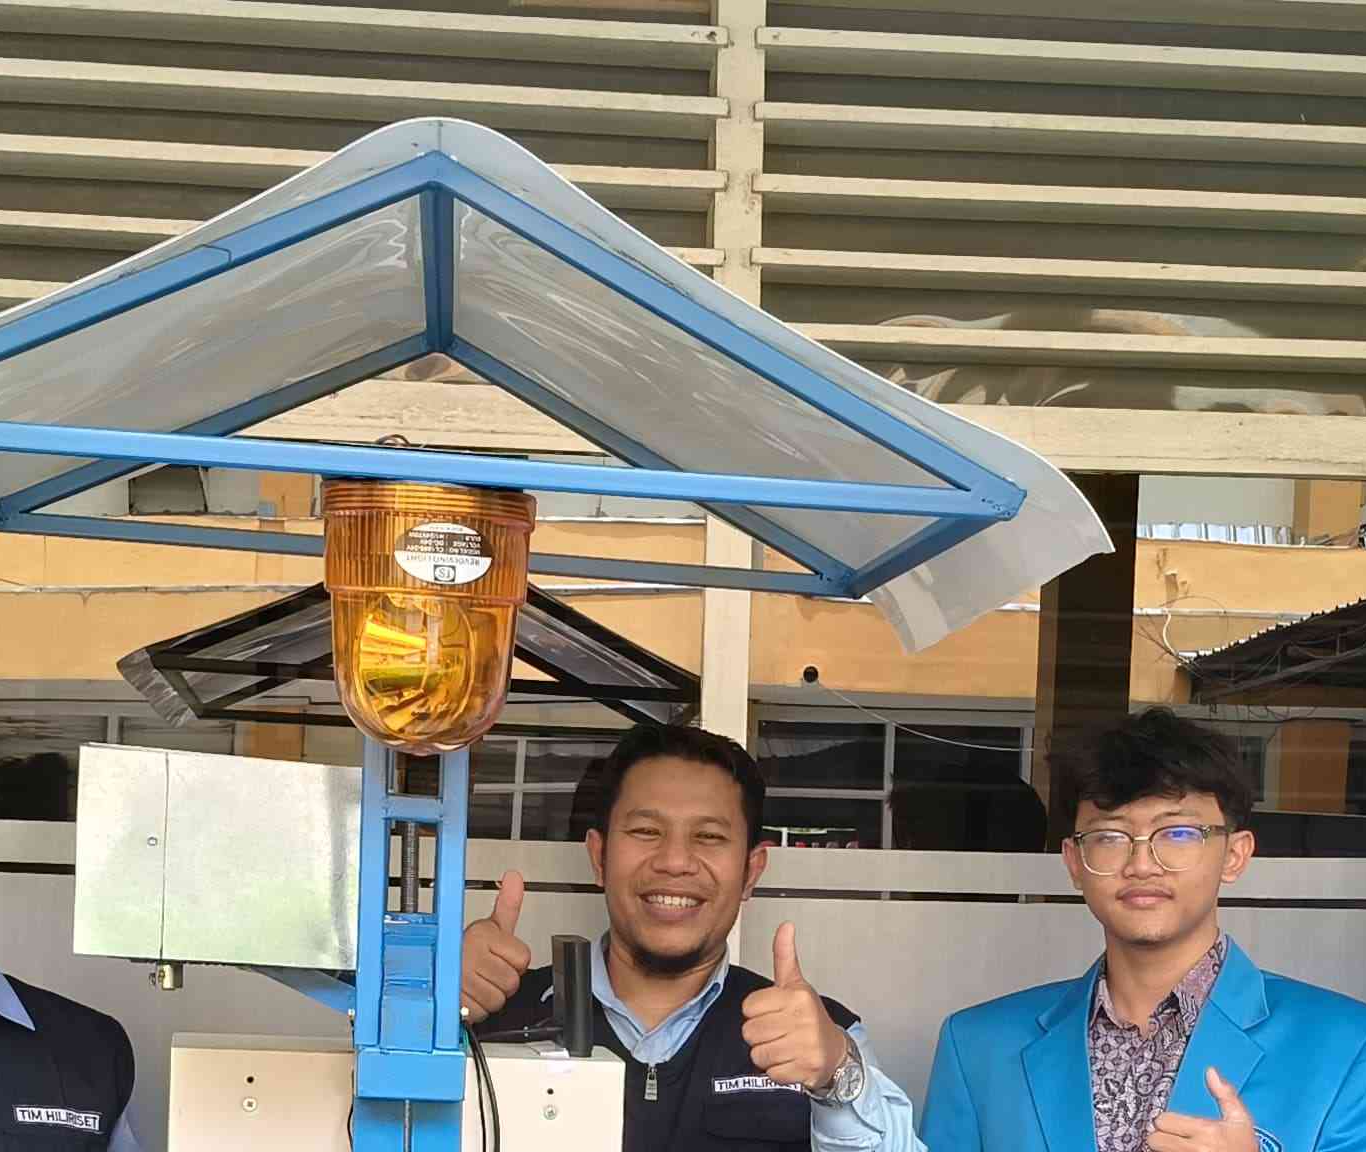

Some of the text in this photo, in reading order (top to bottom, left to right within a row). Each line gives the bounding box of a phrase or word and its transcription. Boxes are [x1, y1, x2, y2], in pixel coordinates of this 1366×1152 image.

[718, 1078, 798, 1090] TIM HILIR
[19, 1110, 98, 1128] TIM HILIRISET
